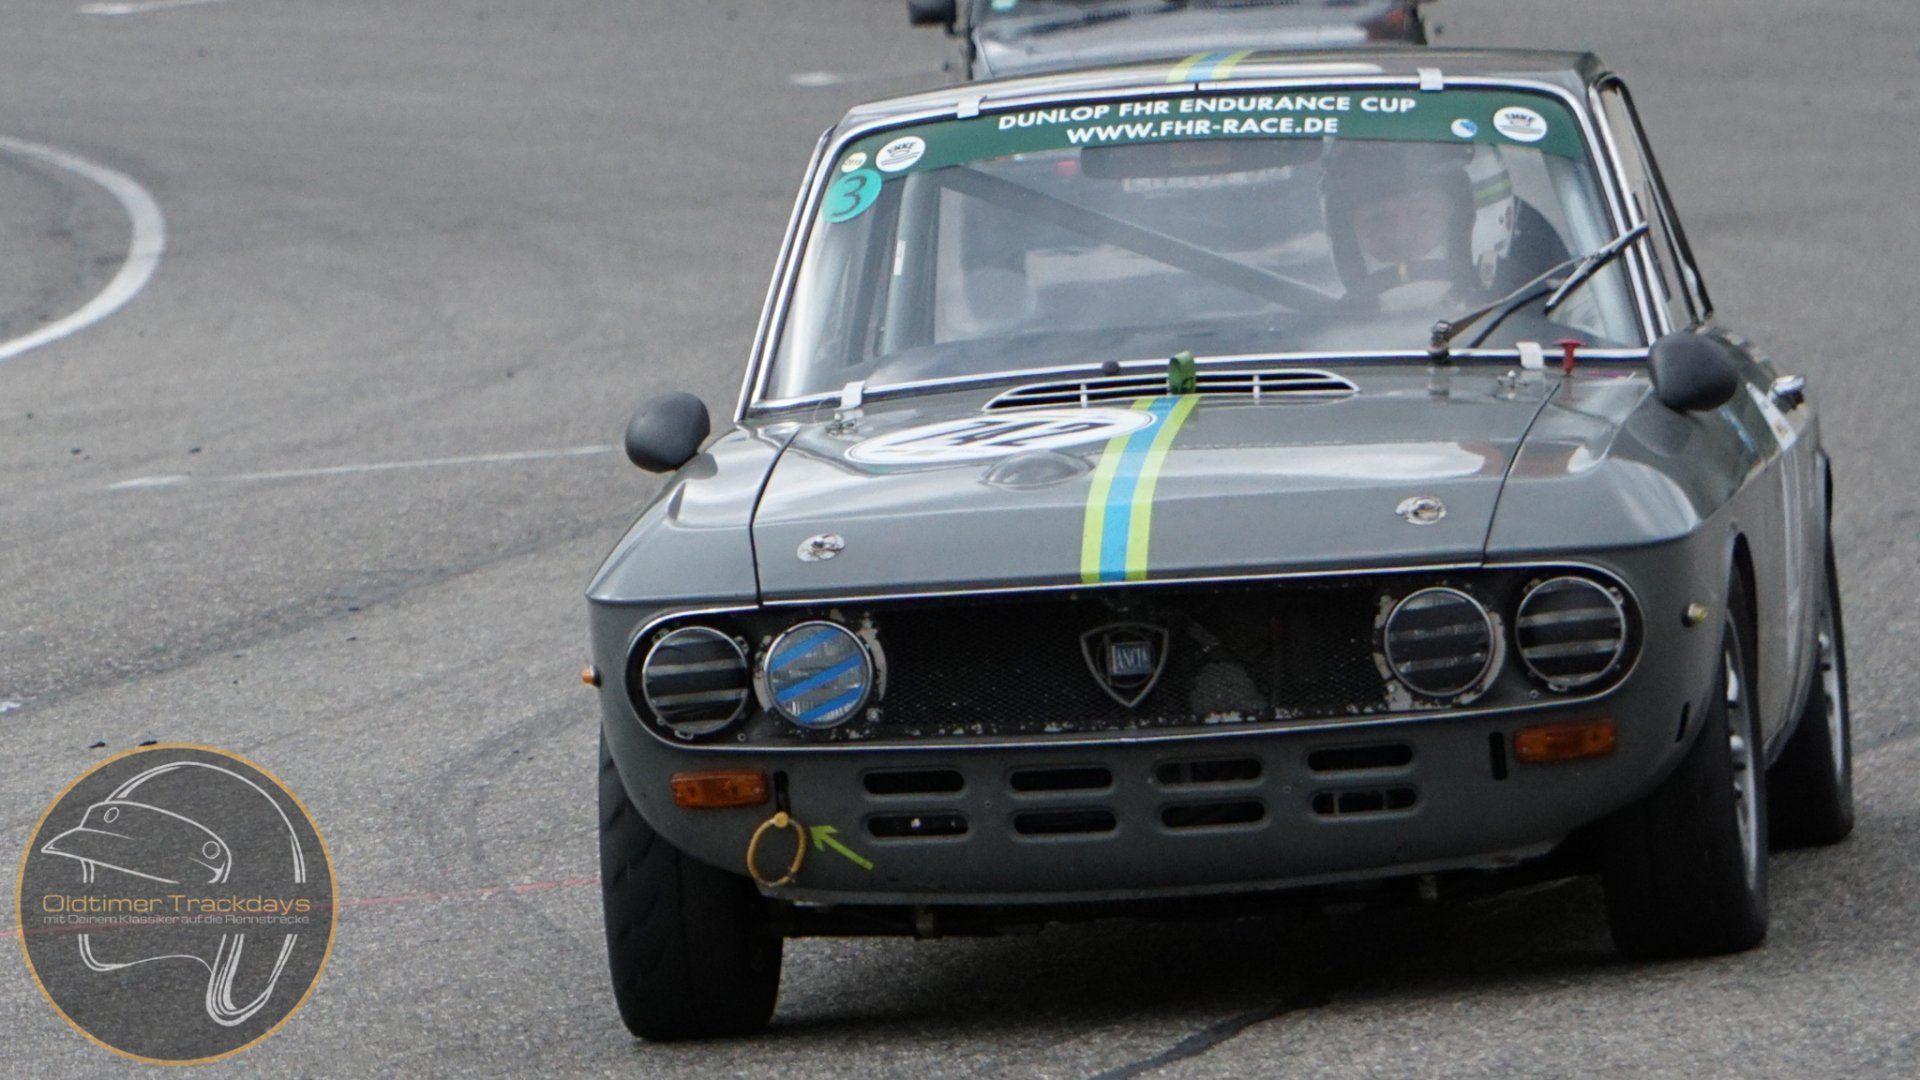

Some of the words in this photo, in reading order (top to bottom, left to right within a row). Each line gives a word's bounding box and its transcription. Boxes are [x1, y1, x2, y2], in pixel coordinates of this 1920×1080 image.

[998, 104, 1110, 130] DUNLOP
[1118, 99, 1169, 117] FHR
[1179, 96, 1350, 113] ENDURANCE
[1360, 97, 1416, 112] CUP
[1066, 117, 1339, 144] WWW.FHR-RACE.DE
[831, 174, 868, 217] 3
